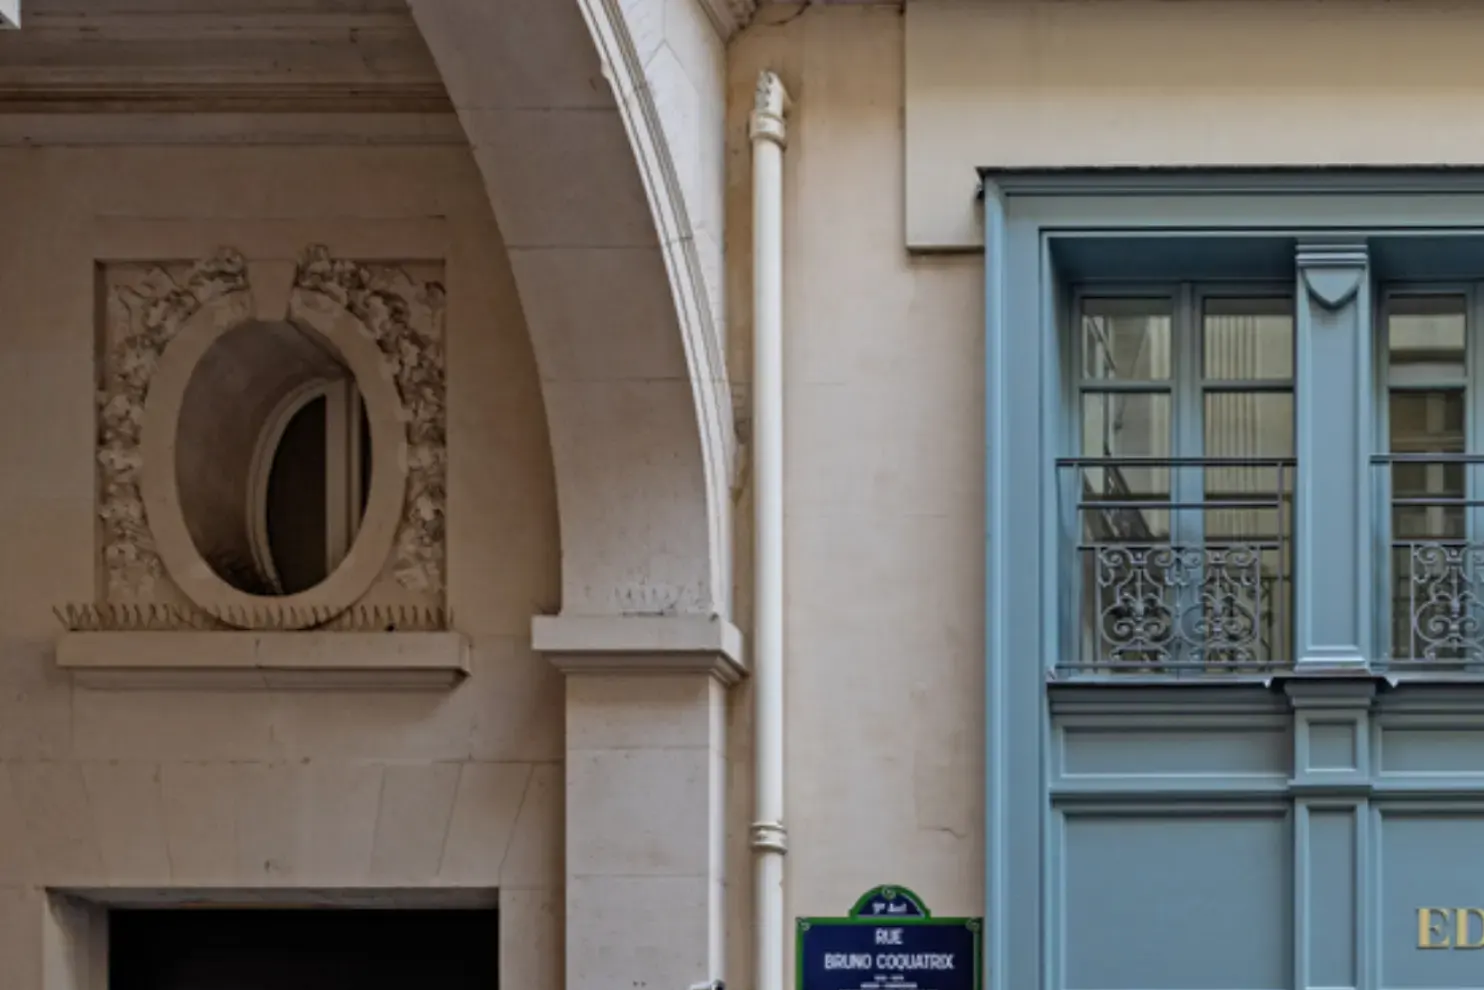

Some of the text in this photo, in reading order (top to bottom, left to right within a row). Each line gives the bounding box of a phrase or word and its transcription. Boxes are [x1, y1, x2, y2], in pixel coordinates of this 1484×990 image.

[874, 928, 904, 945] RUE
[824, 953, 955, 972] BRUNO COQUATRIX
